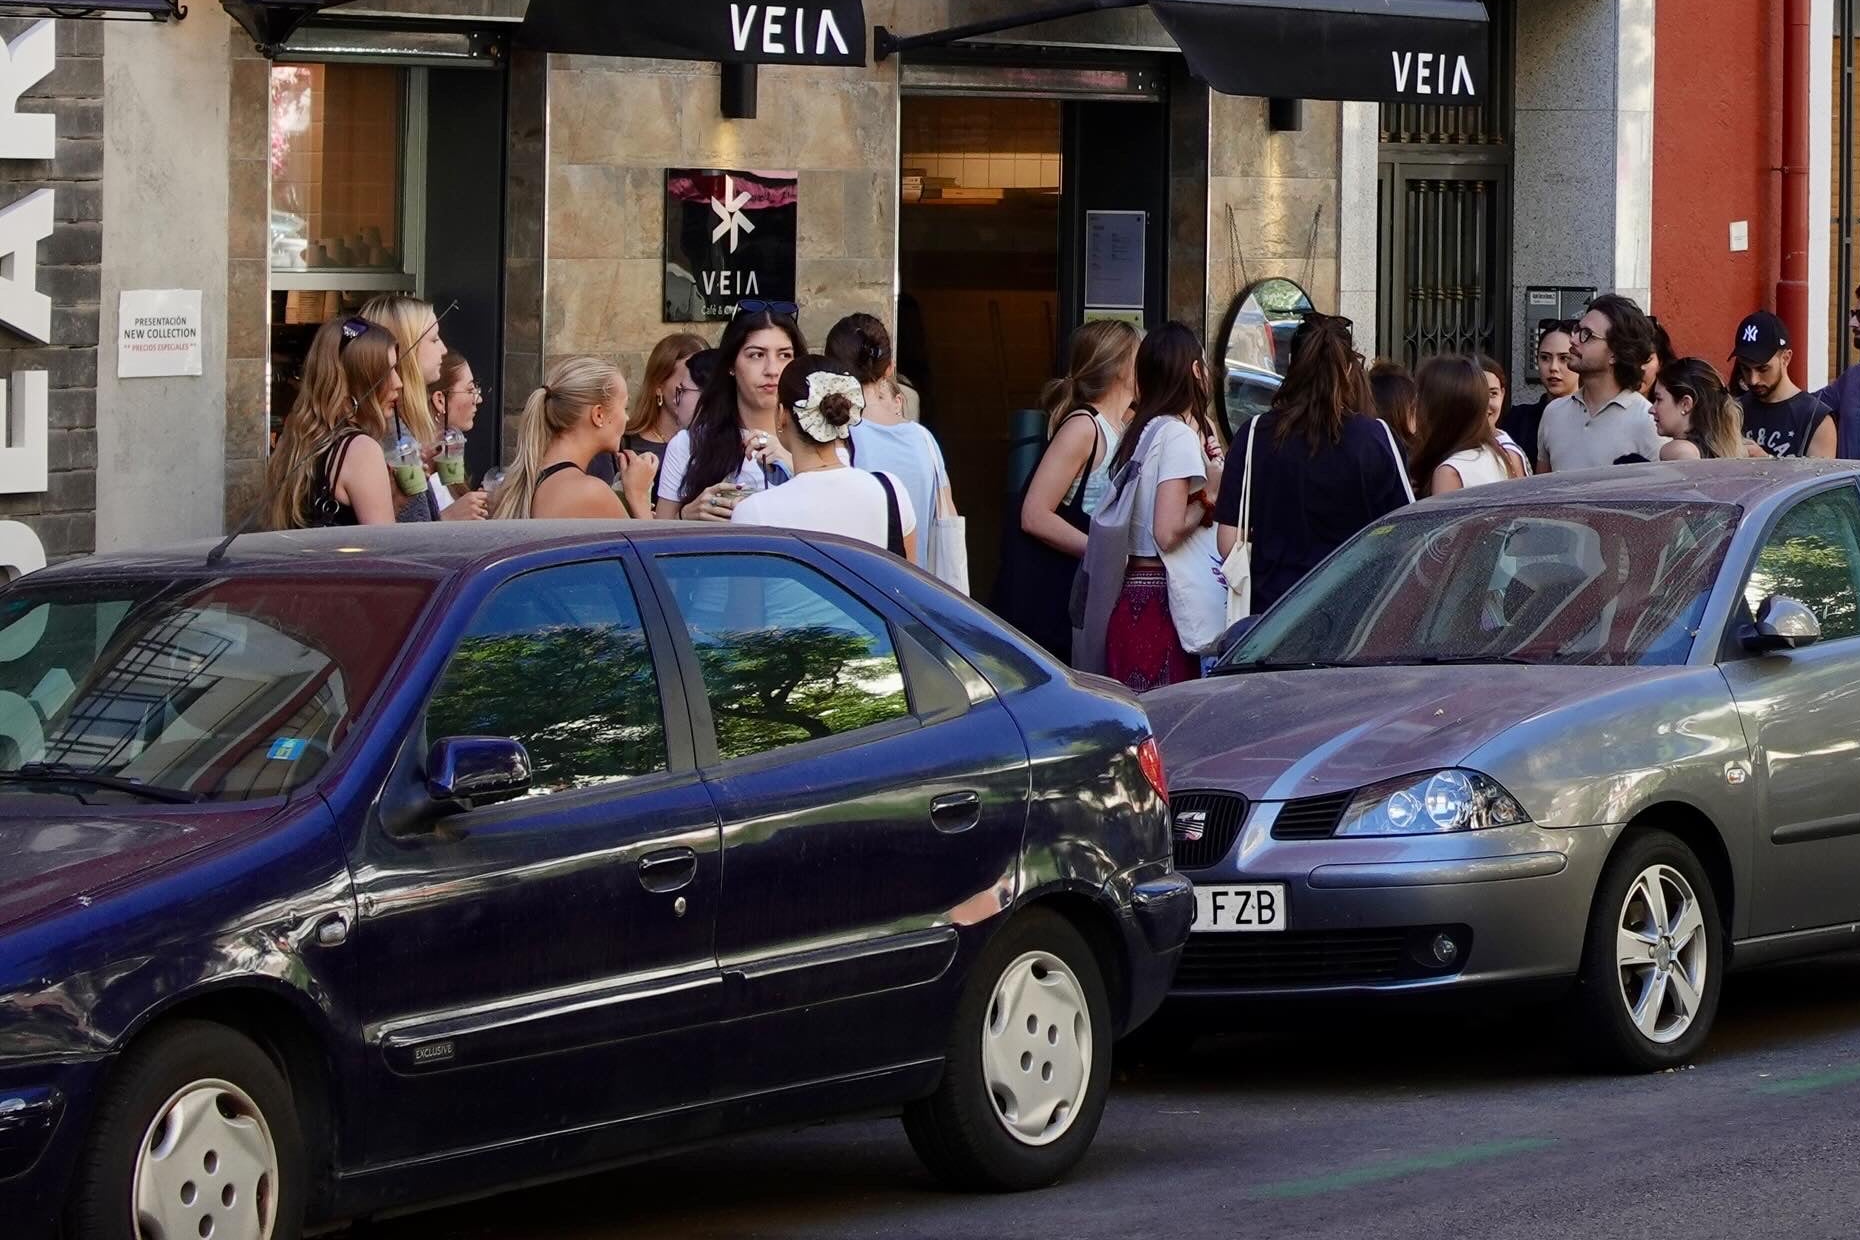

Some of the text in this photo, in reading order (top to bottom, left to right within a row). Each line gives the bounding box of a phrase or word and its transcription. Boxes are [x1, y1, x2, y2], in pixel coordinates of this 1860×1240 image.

[730, 3, 849, 55] VEIA
[1391, 50, 1475, 96] VEIA
[701, 270, 760, 296] VEIA
[134, 316, 187, 327] PRESENTACIÓN
[123, 327, 197, 339] NEW COLLECTION
[1742, 324, 1759, 342] NY
[132, 343, 156, 352] PRECIOS
[1211, 890, 1276, 926] FZB
[415, 1044, 453, 1059] EXCLUSIVE
